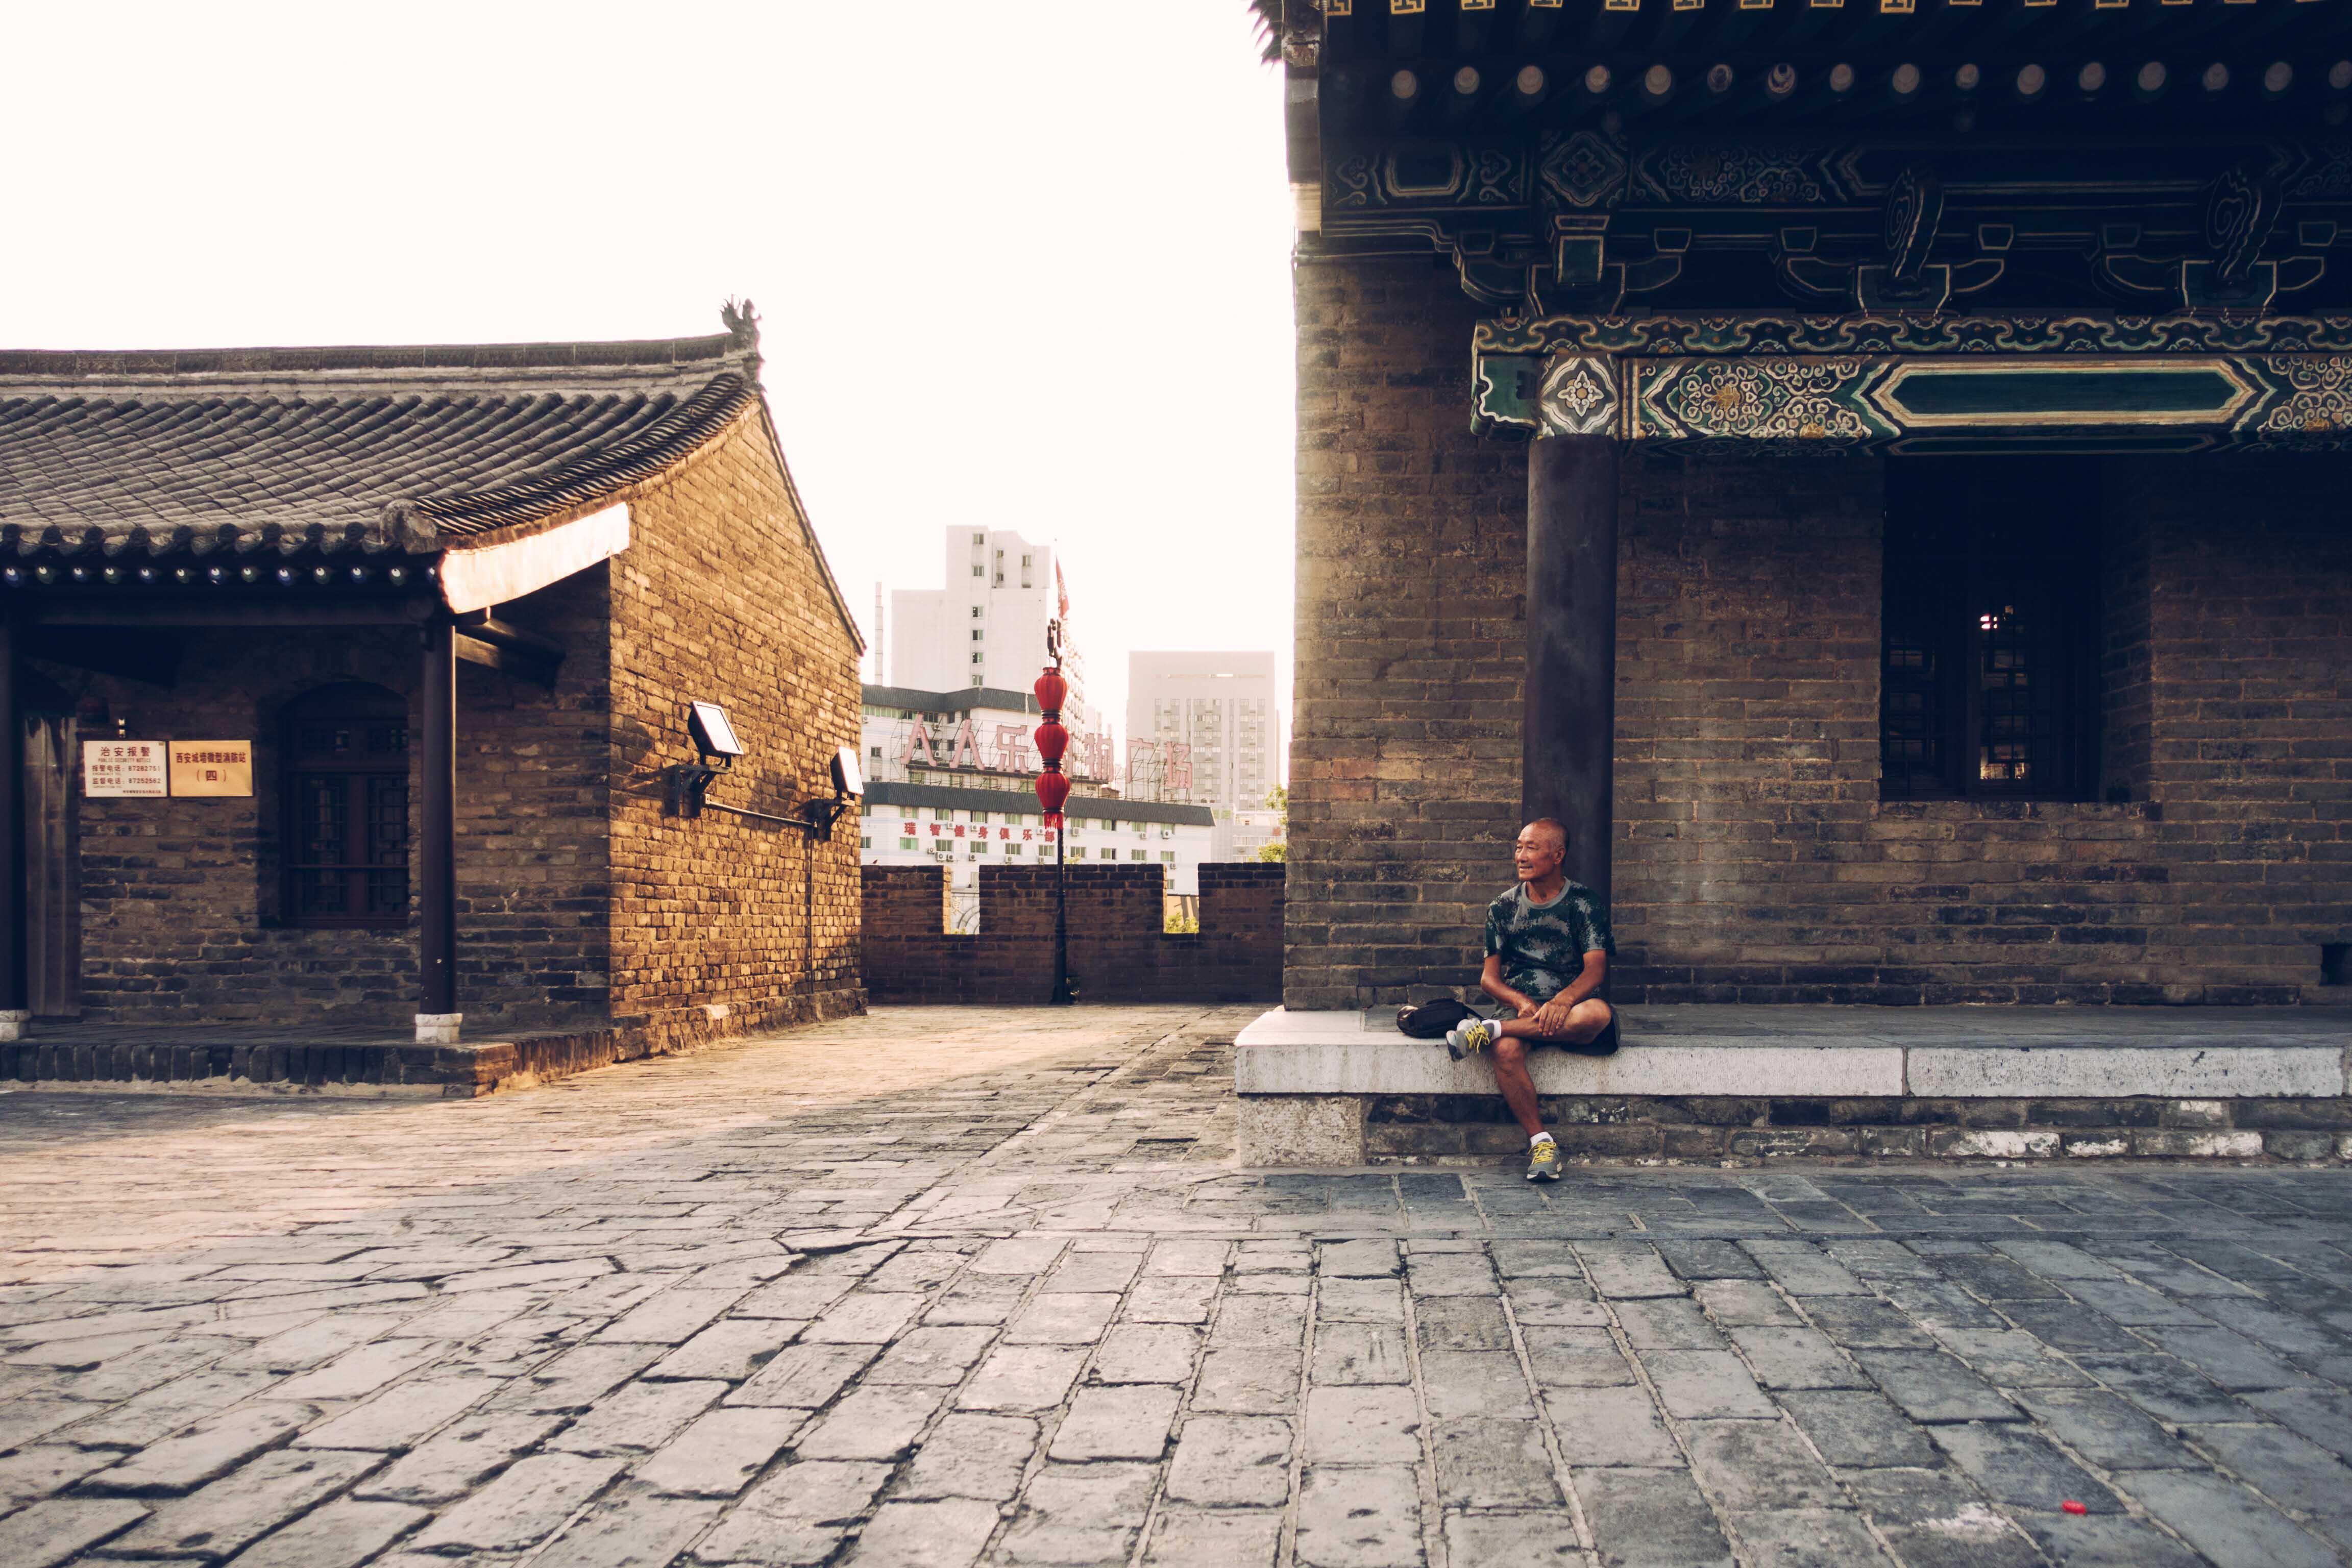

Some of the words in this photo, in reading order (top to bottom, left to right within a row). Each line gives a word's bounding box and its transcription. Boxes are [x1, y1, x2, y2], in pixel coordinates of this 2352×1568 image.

[101, 747, 151, 757] 治安报警
[176, 752, 246, 764] 西安城墙微型消防站
[900, 713, 1193, 789] 人人乐物广场
[904, 822, 1055, 843] 瑞智健身俱乐部
